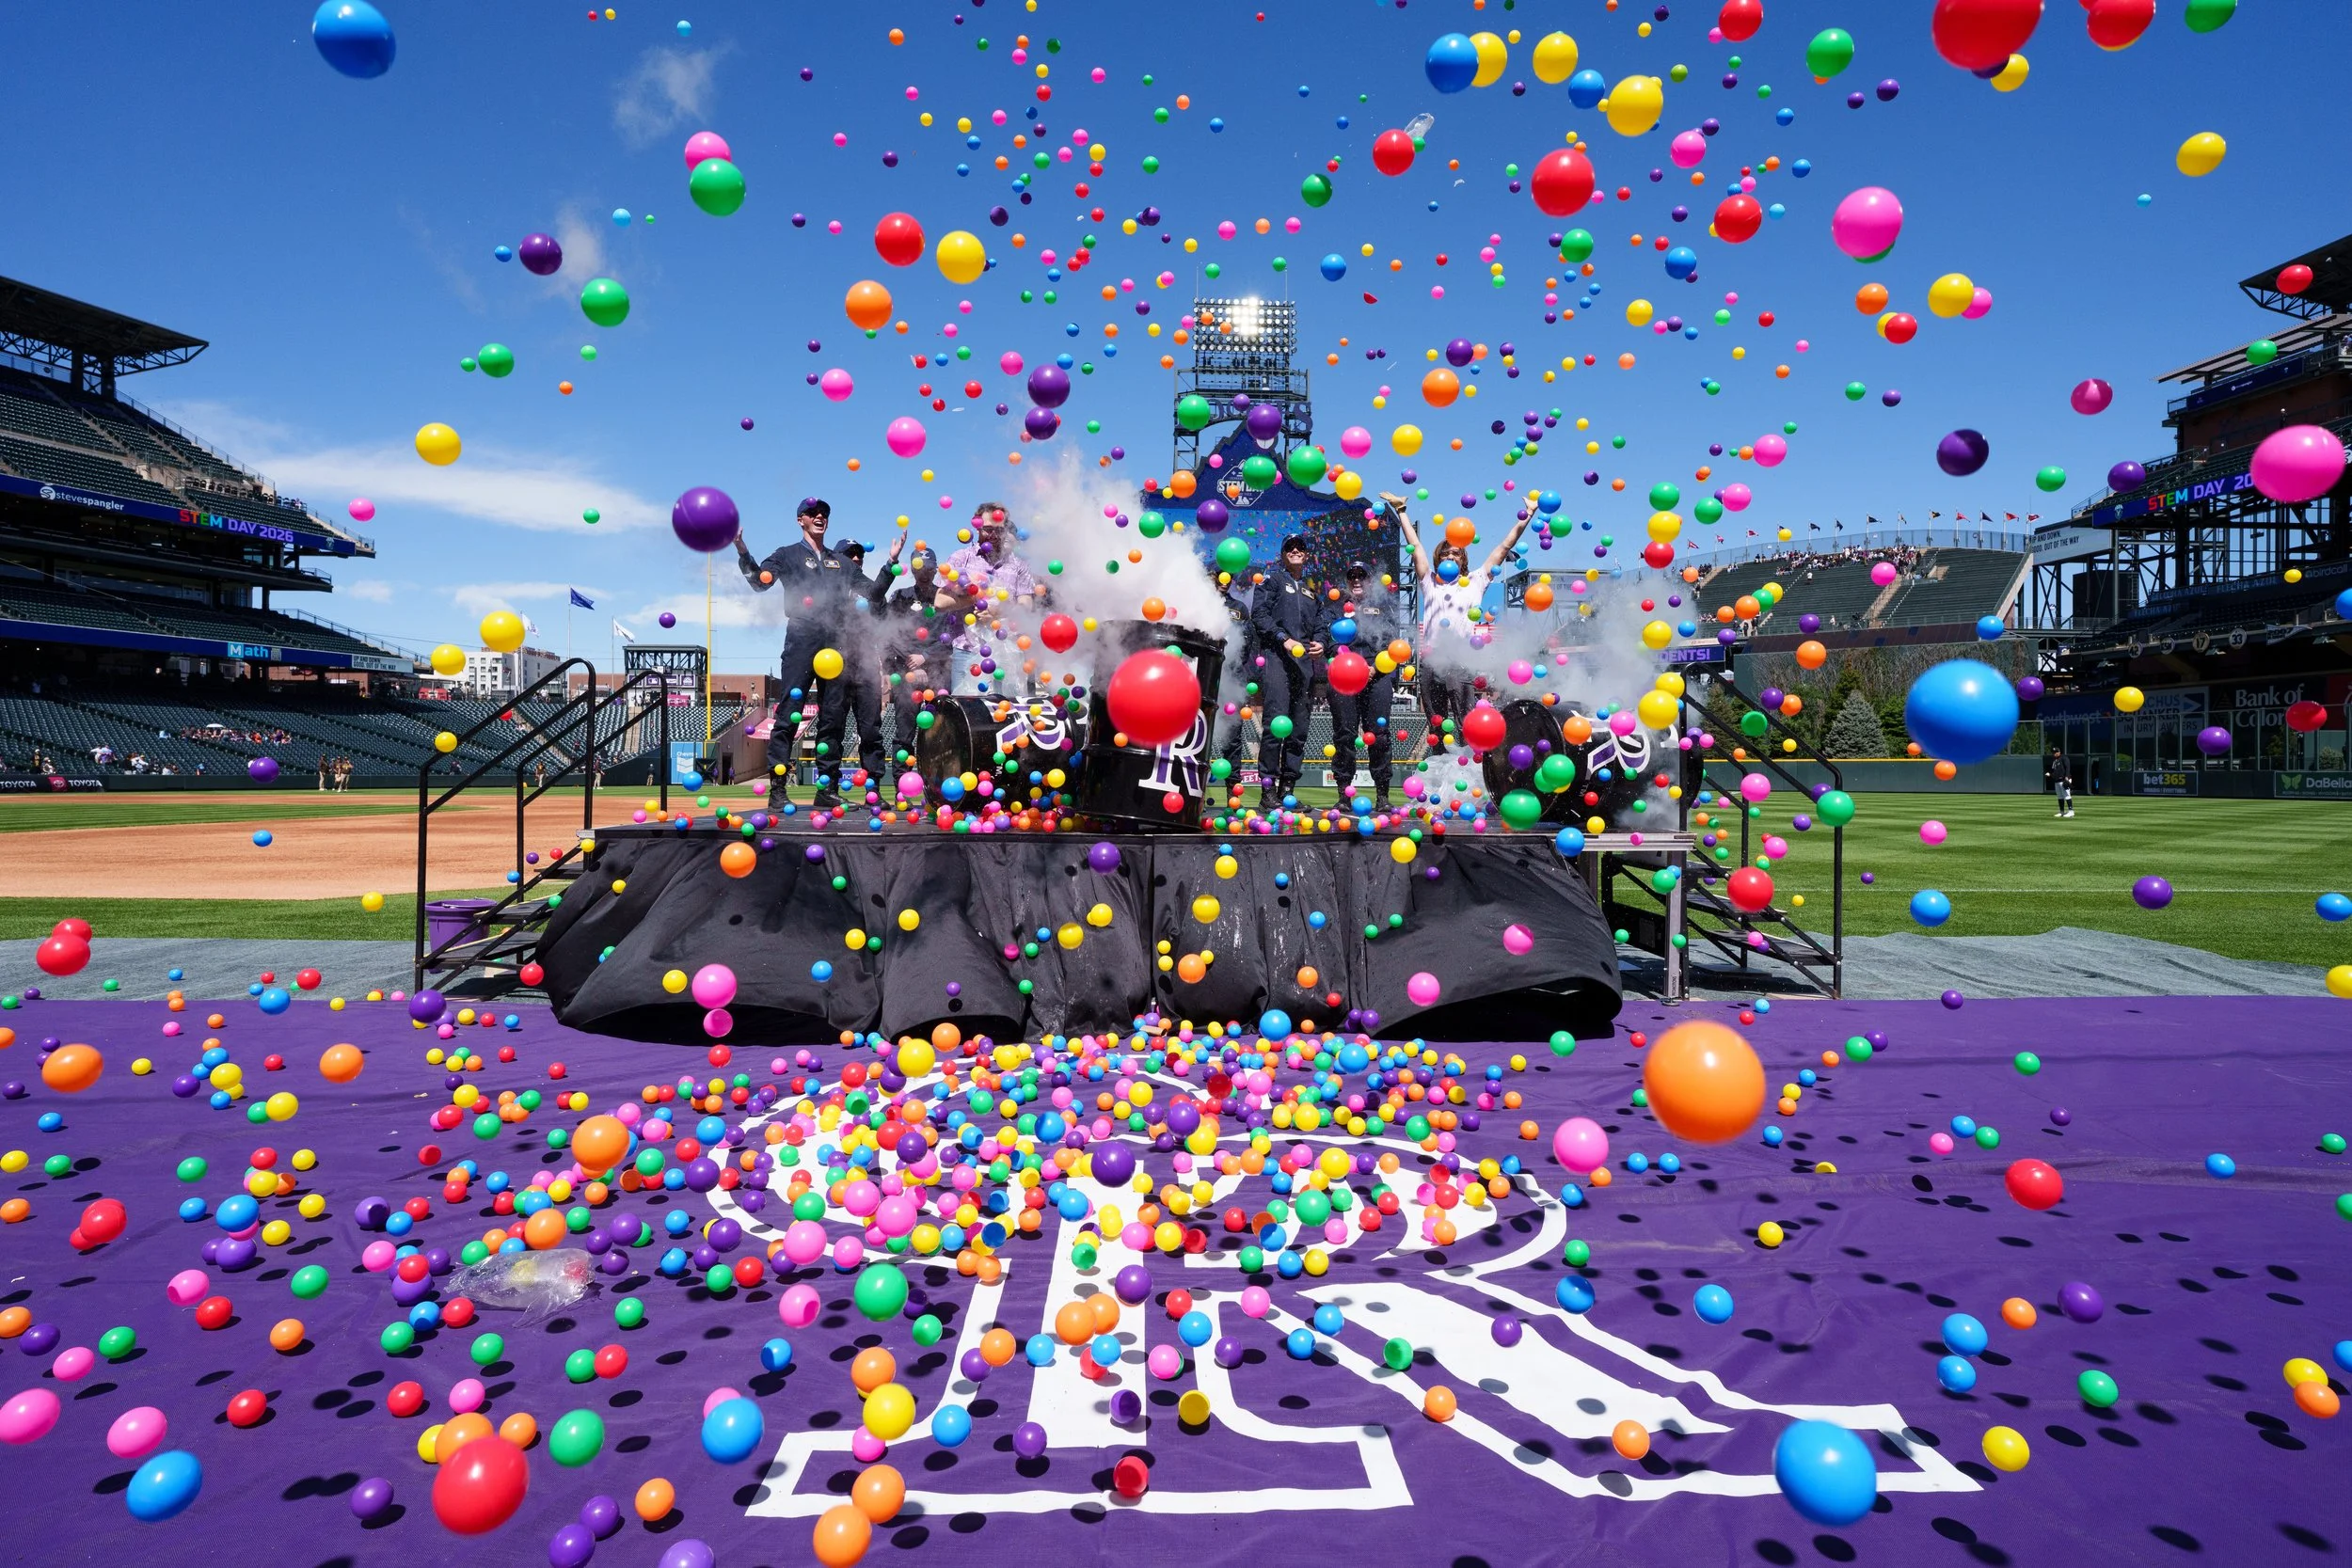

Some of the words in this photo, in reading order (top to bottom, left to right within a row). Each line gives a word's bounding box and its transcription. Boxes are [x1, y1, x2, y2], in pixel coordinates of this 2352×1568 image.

[2148, 488, 2188, 511] STEM
[2193, 478, 2225, 499] DAY
[2233, 473, 2254, 491] 20
[56, 491, 124, 511] stevespangler
[179, 509, 223, 529] STEM
[228, 518, 257, 534] DAY
[259, 526, 294, 543] 2026
[2070, 535, 2080, 545] WAY
[229, 643, 269, 658] Math
[2145, 694, 2180, 707] CHUS
[2235, 685, 2281, 707] Bank
[2284, 682, 2305, 704] of
[2235, 707, 2284, 728] Color
[2123, 721, 2153, 735] INURY
[0, 780, 37, 789] TOYOTA
[2143, 773, 2186, 785] bet365
[2306, 777, 2352, 788] DaBella
